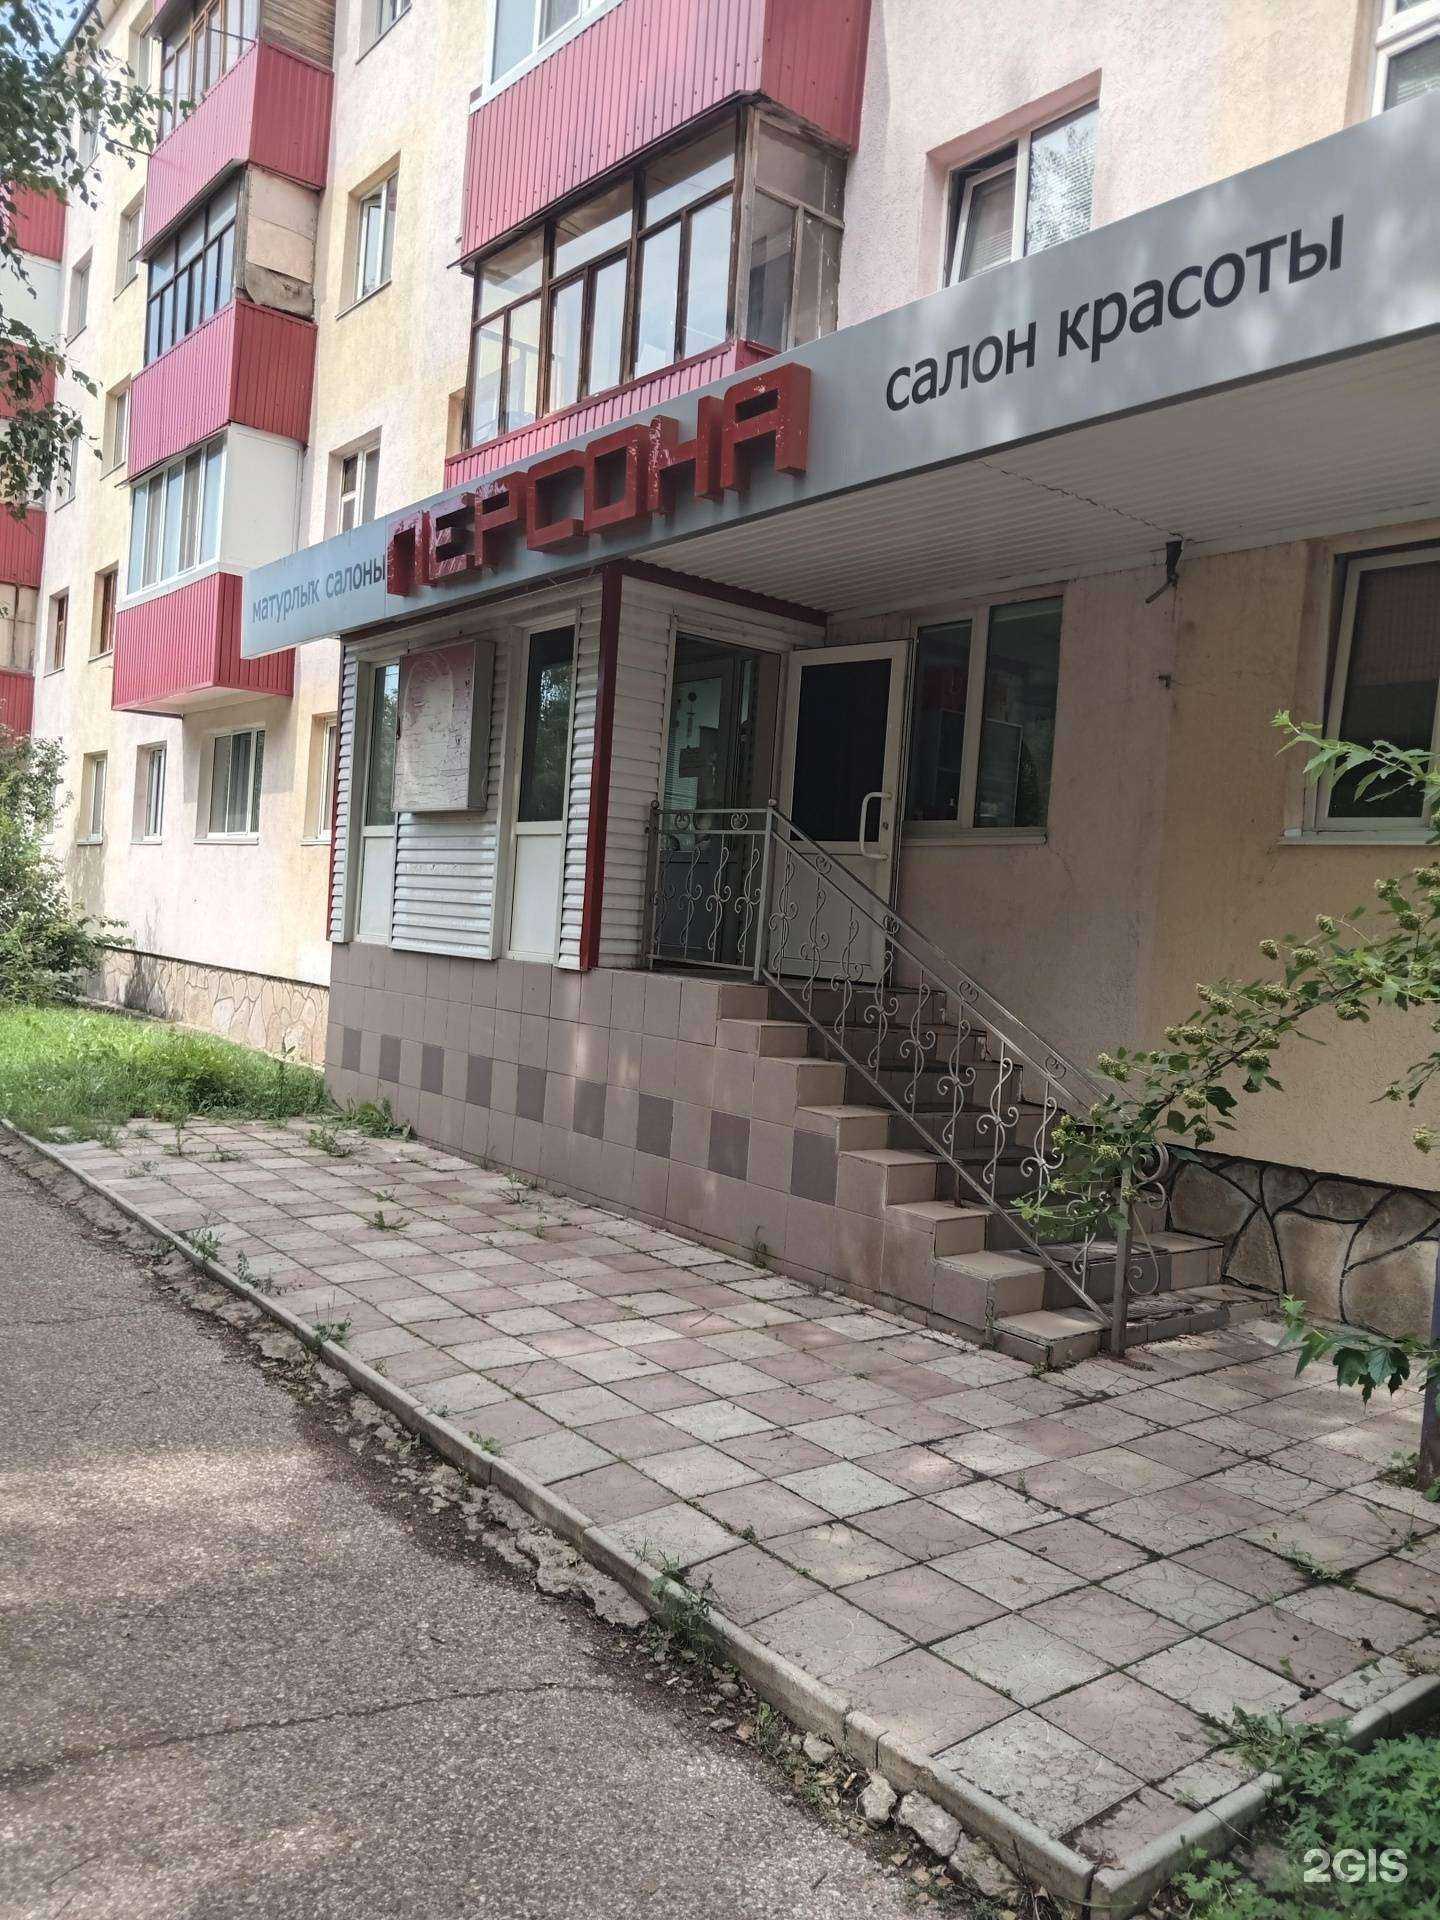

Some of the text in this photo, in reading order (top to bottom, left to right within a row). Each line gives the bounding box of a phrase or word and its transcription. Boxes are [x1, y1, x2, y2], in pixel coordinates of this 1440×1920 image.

[886, 214, 1344, 412] салон красоты
[325, 555, 386, 598] салоны
[386, 362, 811, 597] ПЕРСОНА
